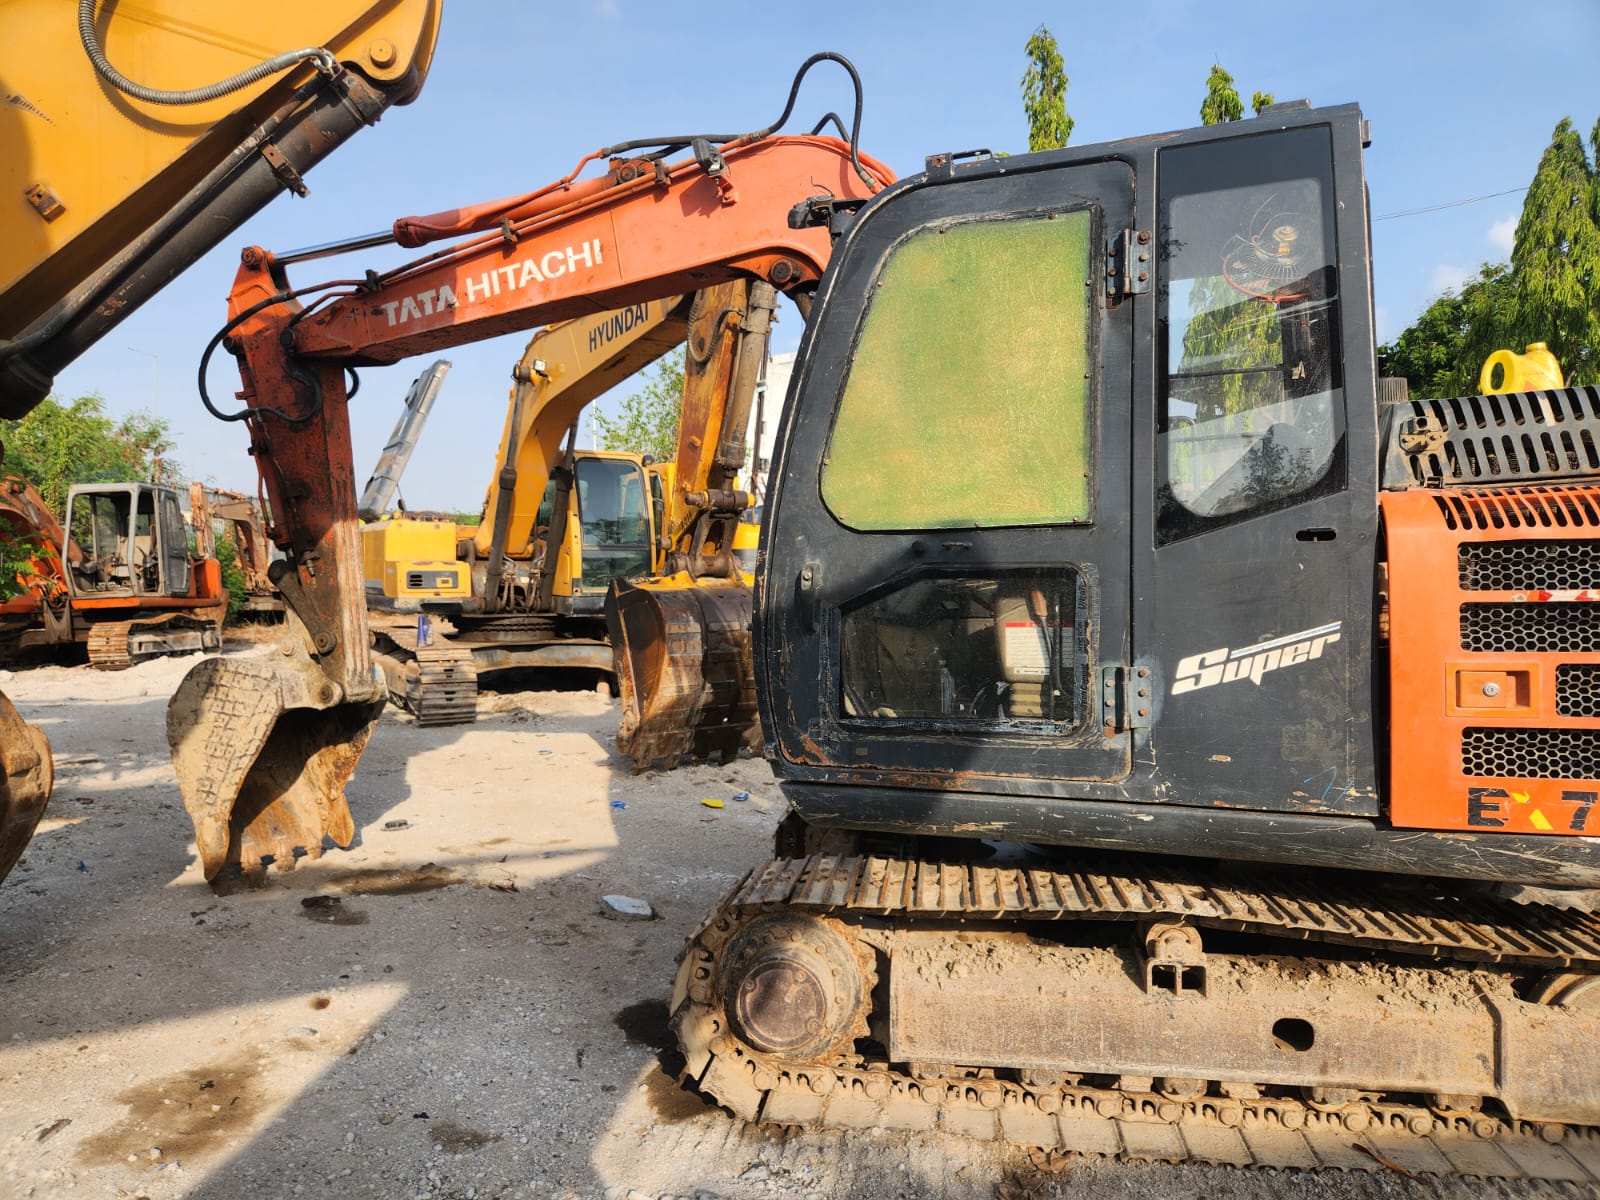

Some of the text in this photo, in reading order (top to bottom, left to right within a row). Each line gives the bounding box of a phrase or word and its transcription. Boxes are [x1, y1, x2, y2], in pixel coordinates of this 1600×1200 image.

[382, 238, 604, 327] TATA HITACHI
[588, 302, 649, 353] HYUNDAI
[1170, 630, 1342, 696] Super
